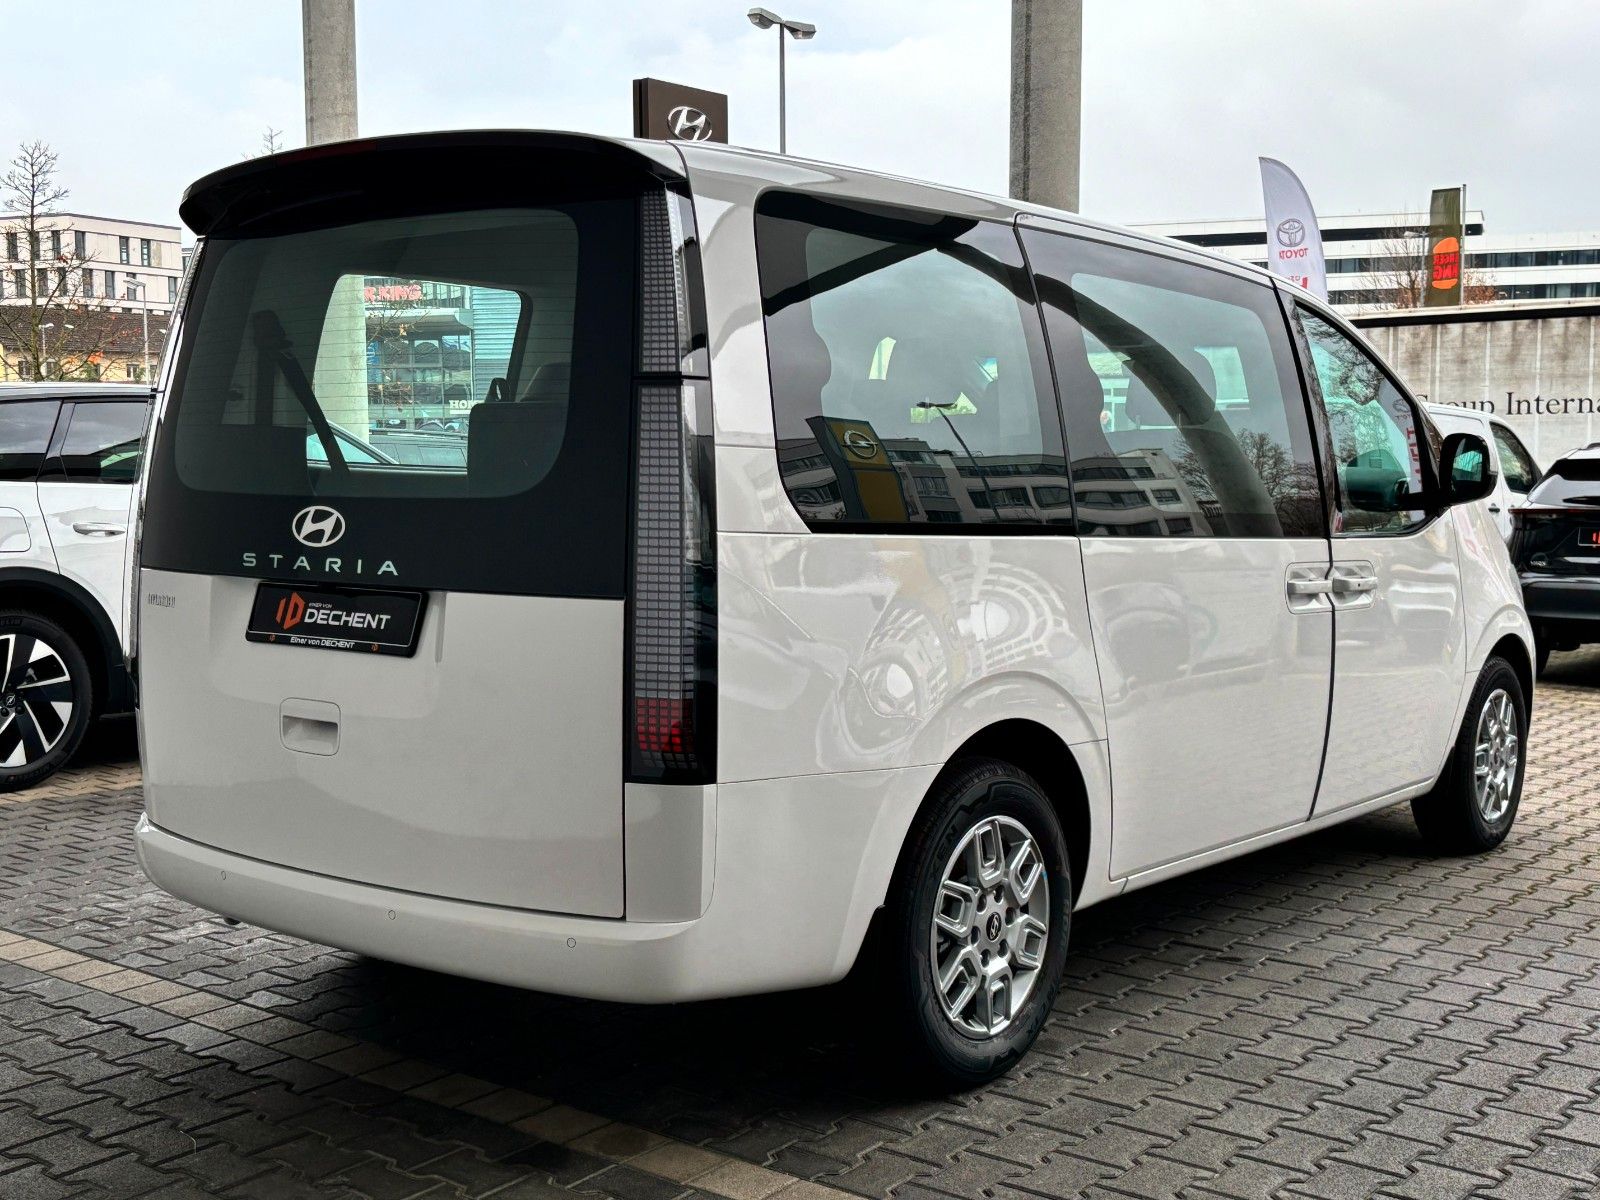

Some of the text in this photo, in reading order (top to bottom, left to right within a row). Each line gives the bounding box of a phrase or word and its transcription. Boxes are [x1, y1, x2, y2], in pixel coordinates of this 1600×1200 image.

[242, 552, 399, 576] STARIA
[304, 608, 391, 630] DECHENT
[290, 636, 356, 649] Einer von DECHENT
